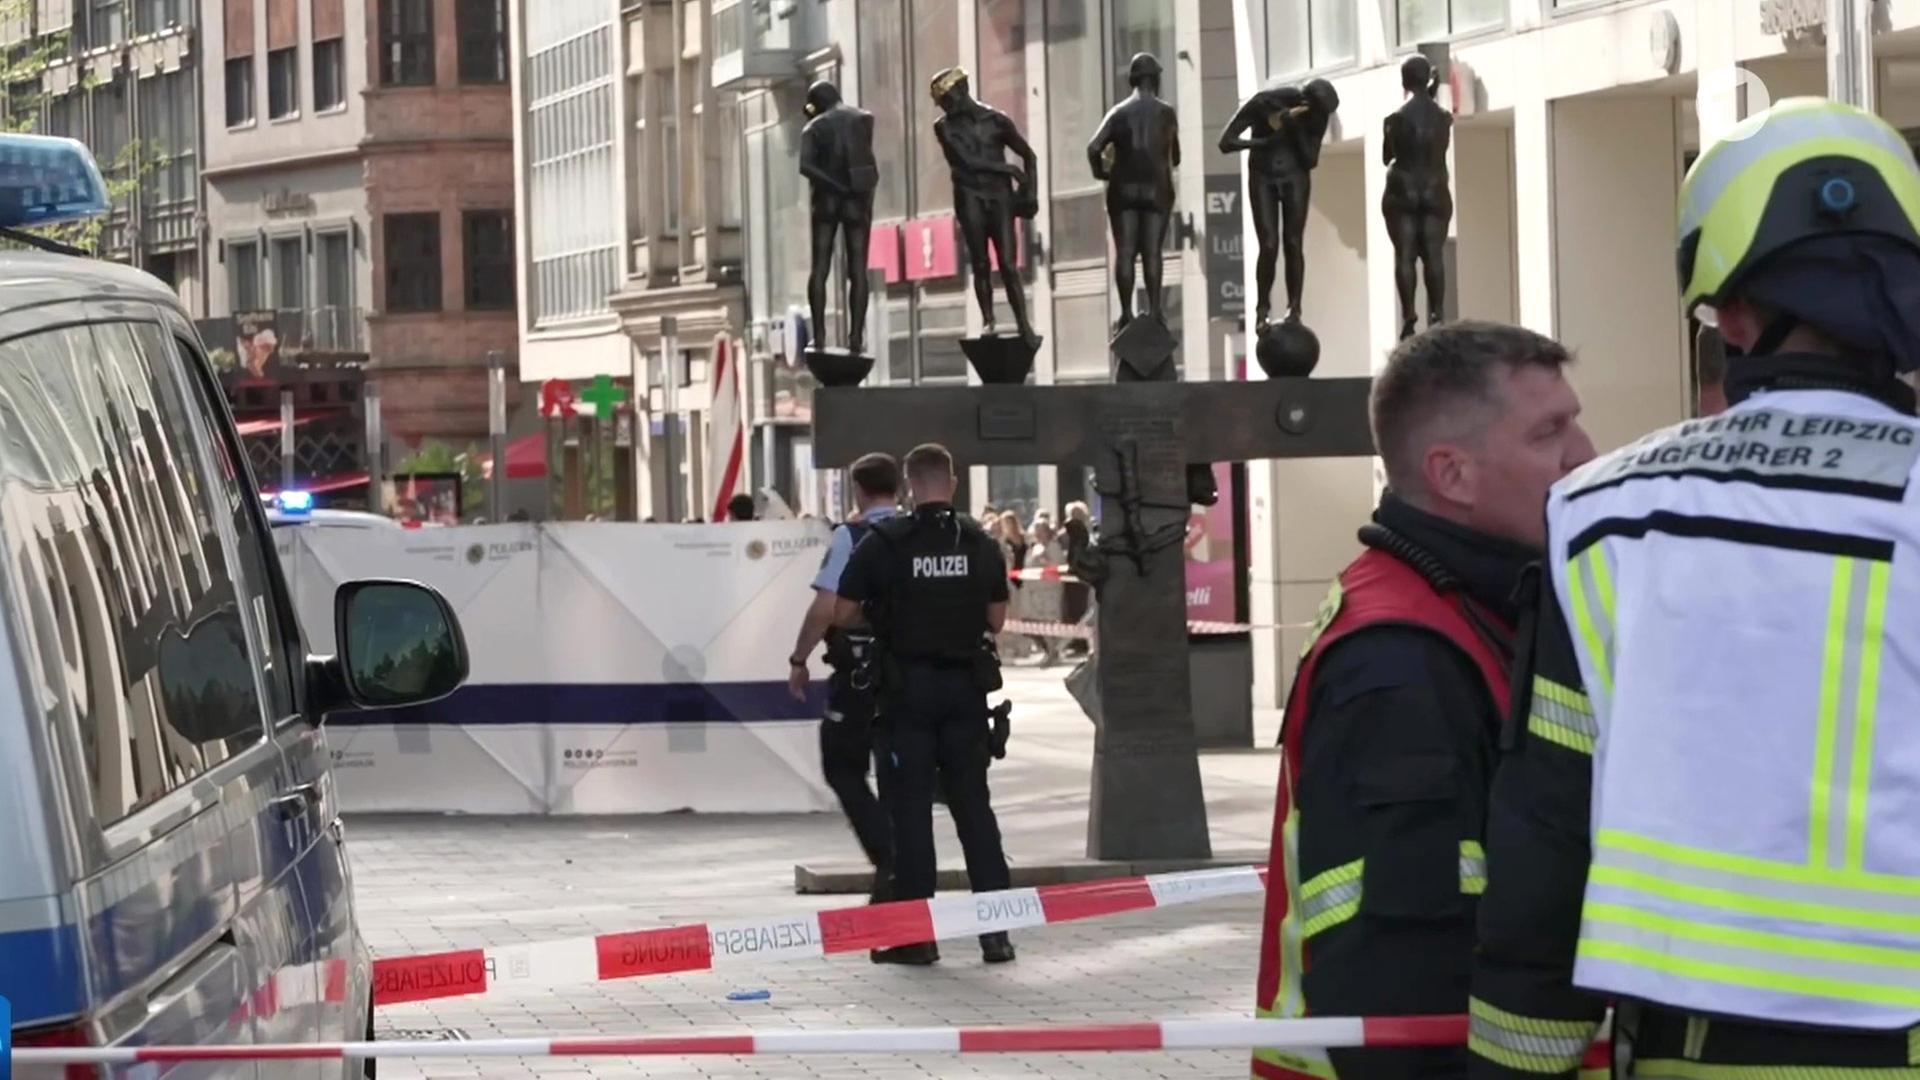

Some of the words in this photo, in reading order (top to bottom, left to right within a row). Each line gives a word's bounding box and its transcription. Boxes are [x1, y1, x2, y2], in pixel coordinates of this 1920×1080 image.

[1206, 191, 1236, 214] EY
[1782, 417, 1914, 446] LEIPZIG
[1821, 447, 1844, 470] 2
[913, 555, 968, 578] POLIZEI
